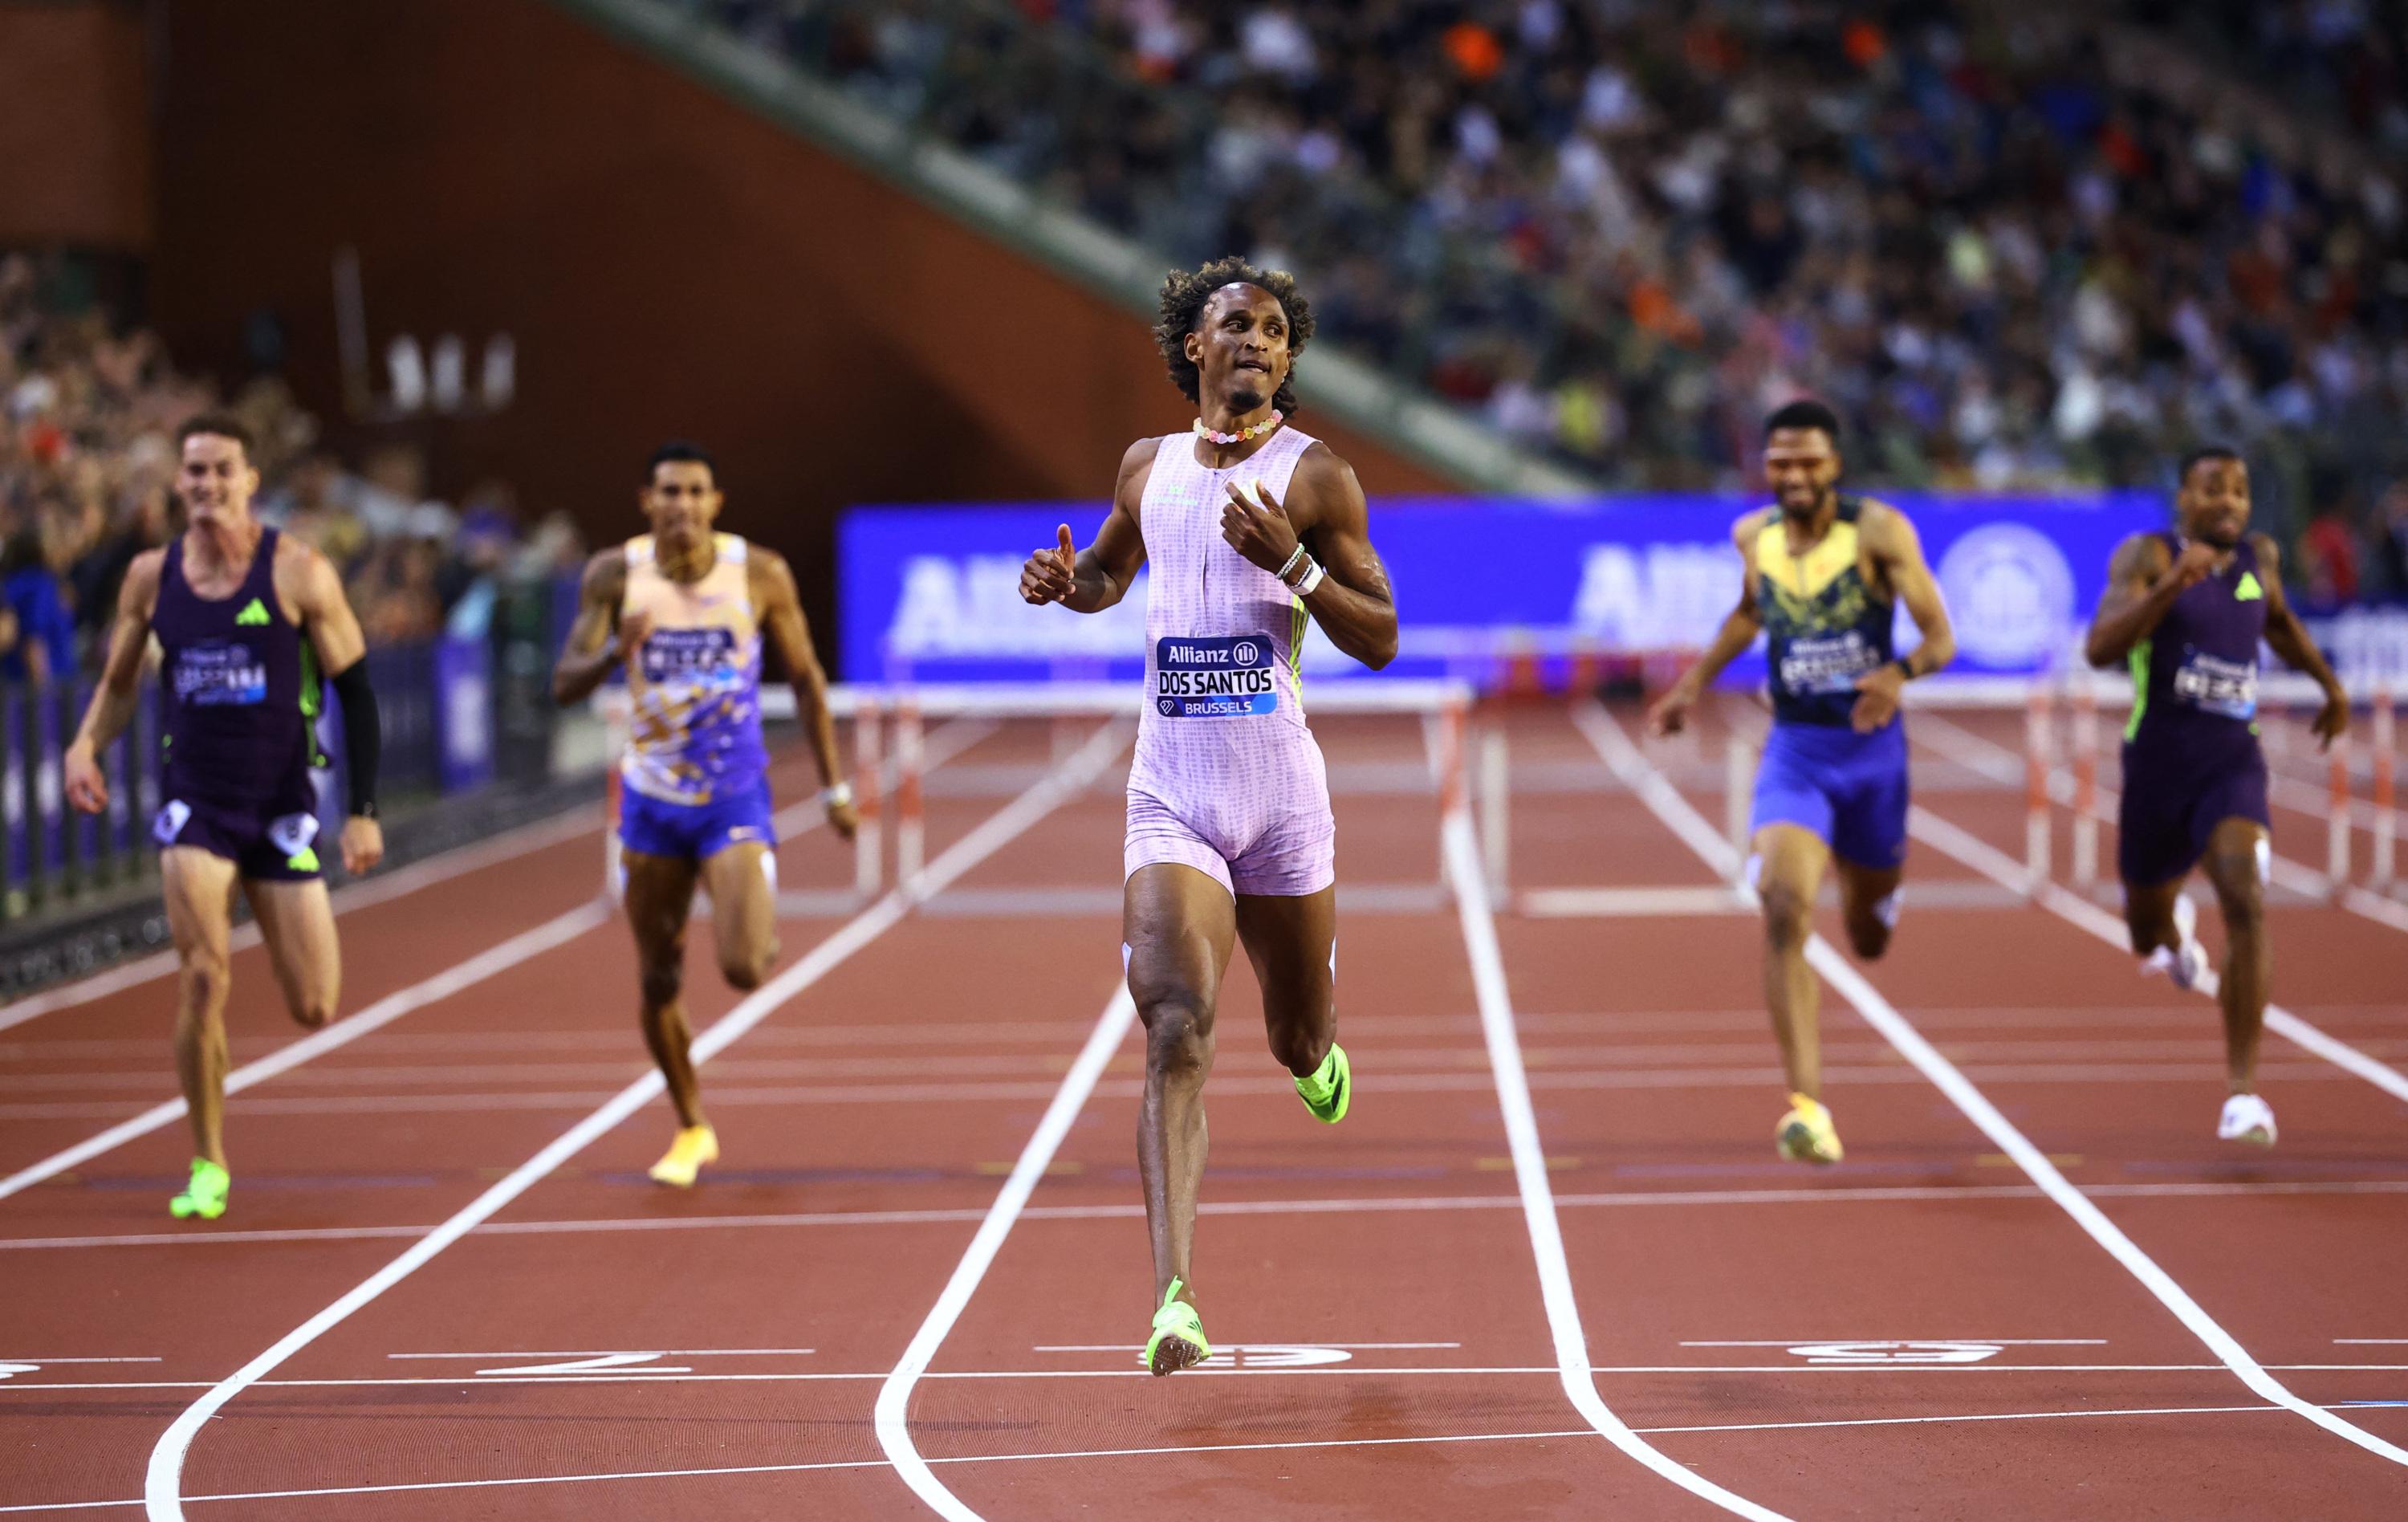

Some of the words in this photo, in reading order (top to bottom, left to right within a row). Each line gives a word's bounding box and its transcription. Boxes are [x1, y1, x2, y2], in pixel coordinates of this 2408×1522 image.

[1168, 645, 1229, 663] Allianz
[1159, 671, 1190, 694] DOS
[1194, 669, 1272, 694] SANTOS
[1185, 701, 1252, 714] BRUSSELS
